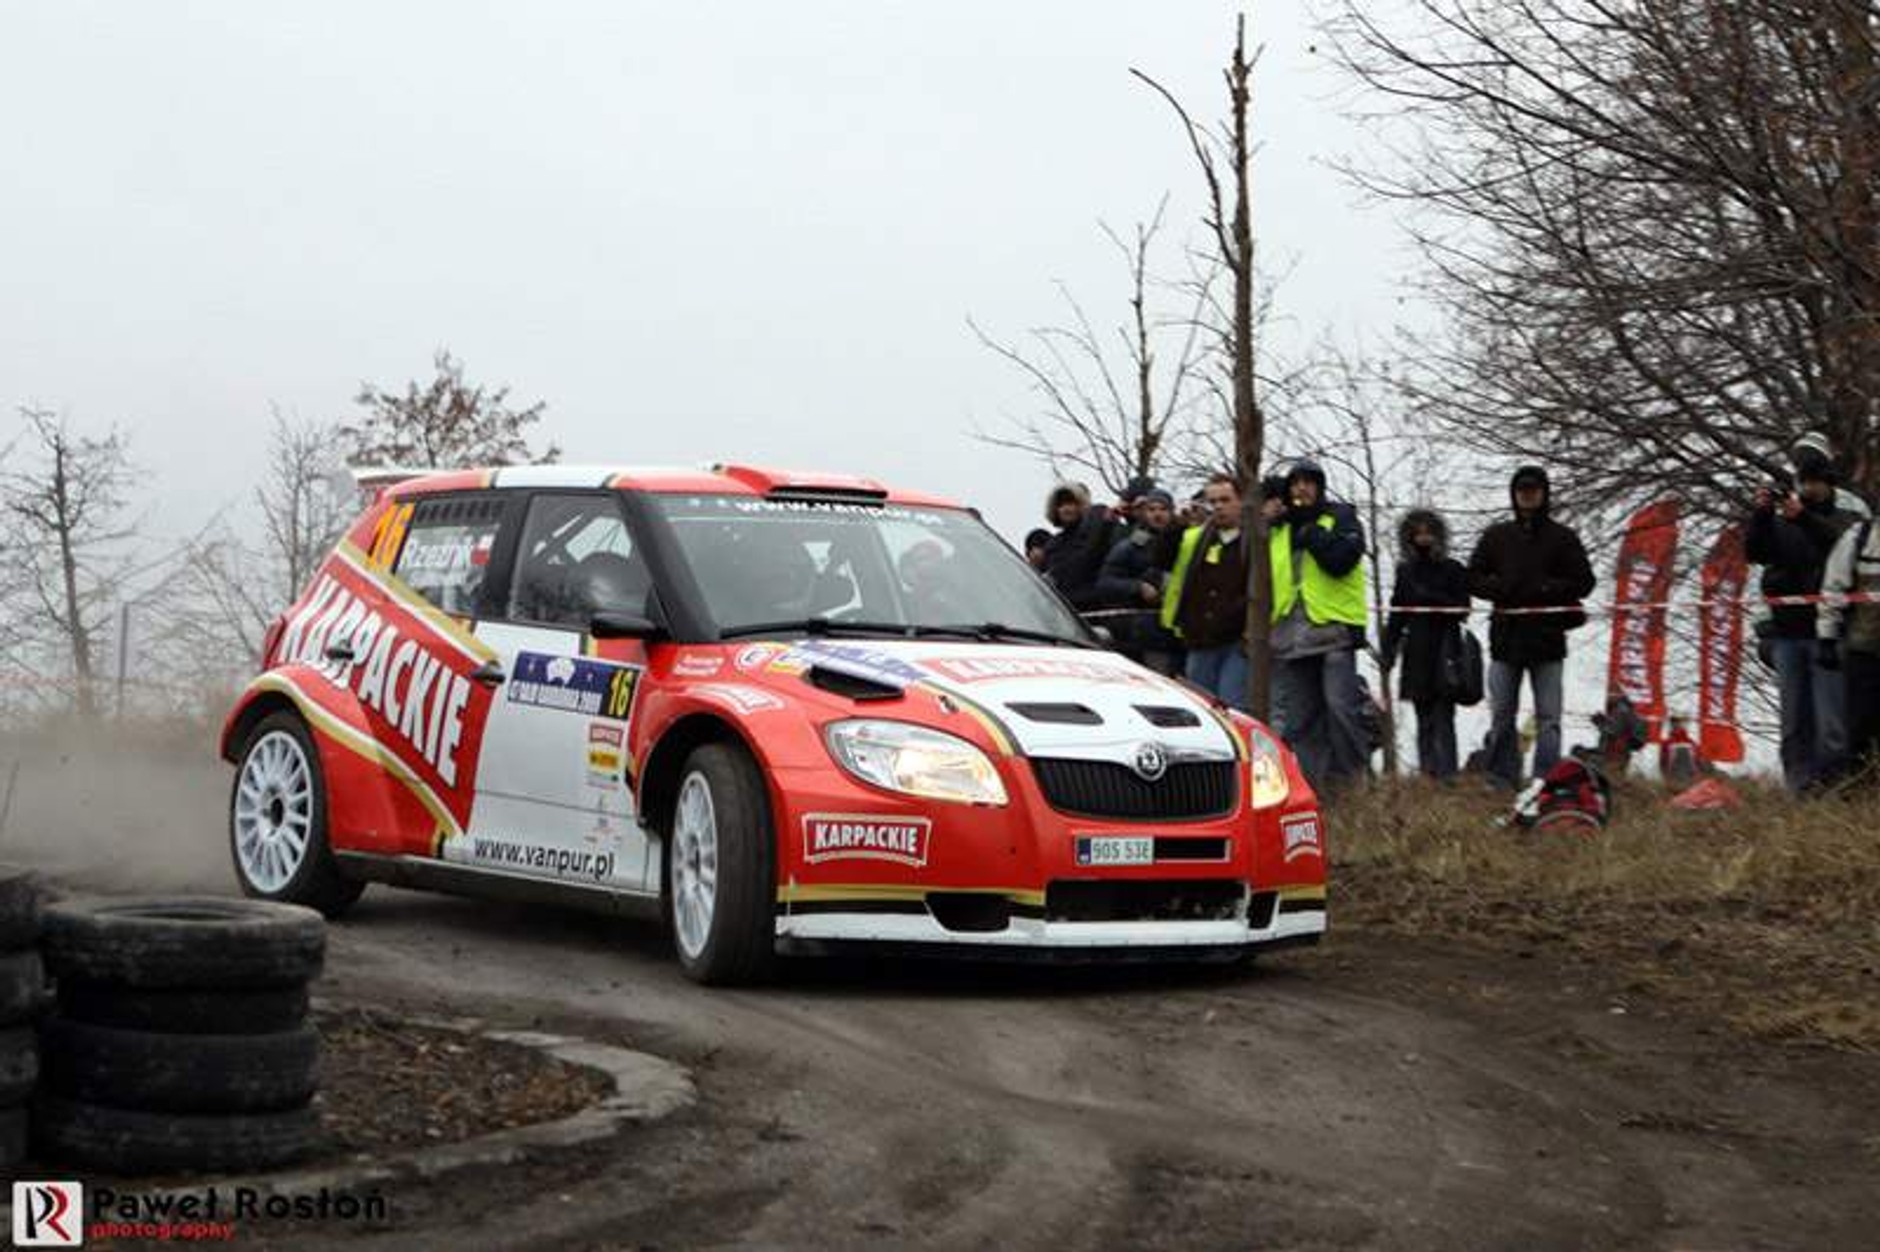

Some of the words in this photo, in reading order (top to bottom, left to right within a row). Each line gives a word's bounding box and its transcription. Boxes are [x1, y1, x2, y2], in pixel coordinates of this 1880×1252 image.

[370, 502, 415, 572] 16
[279, 574, 471, 789] KARPACKIE
[608, 668, 634, 717] 16
[475, 838, 614, 879] www.vanpur.pl
[815, 824, 918, 853] KARPACKIE
